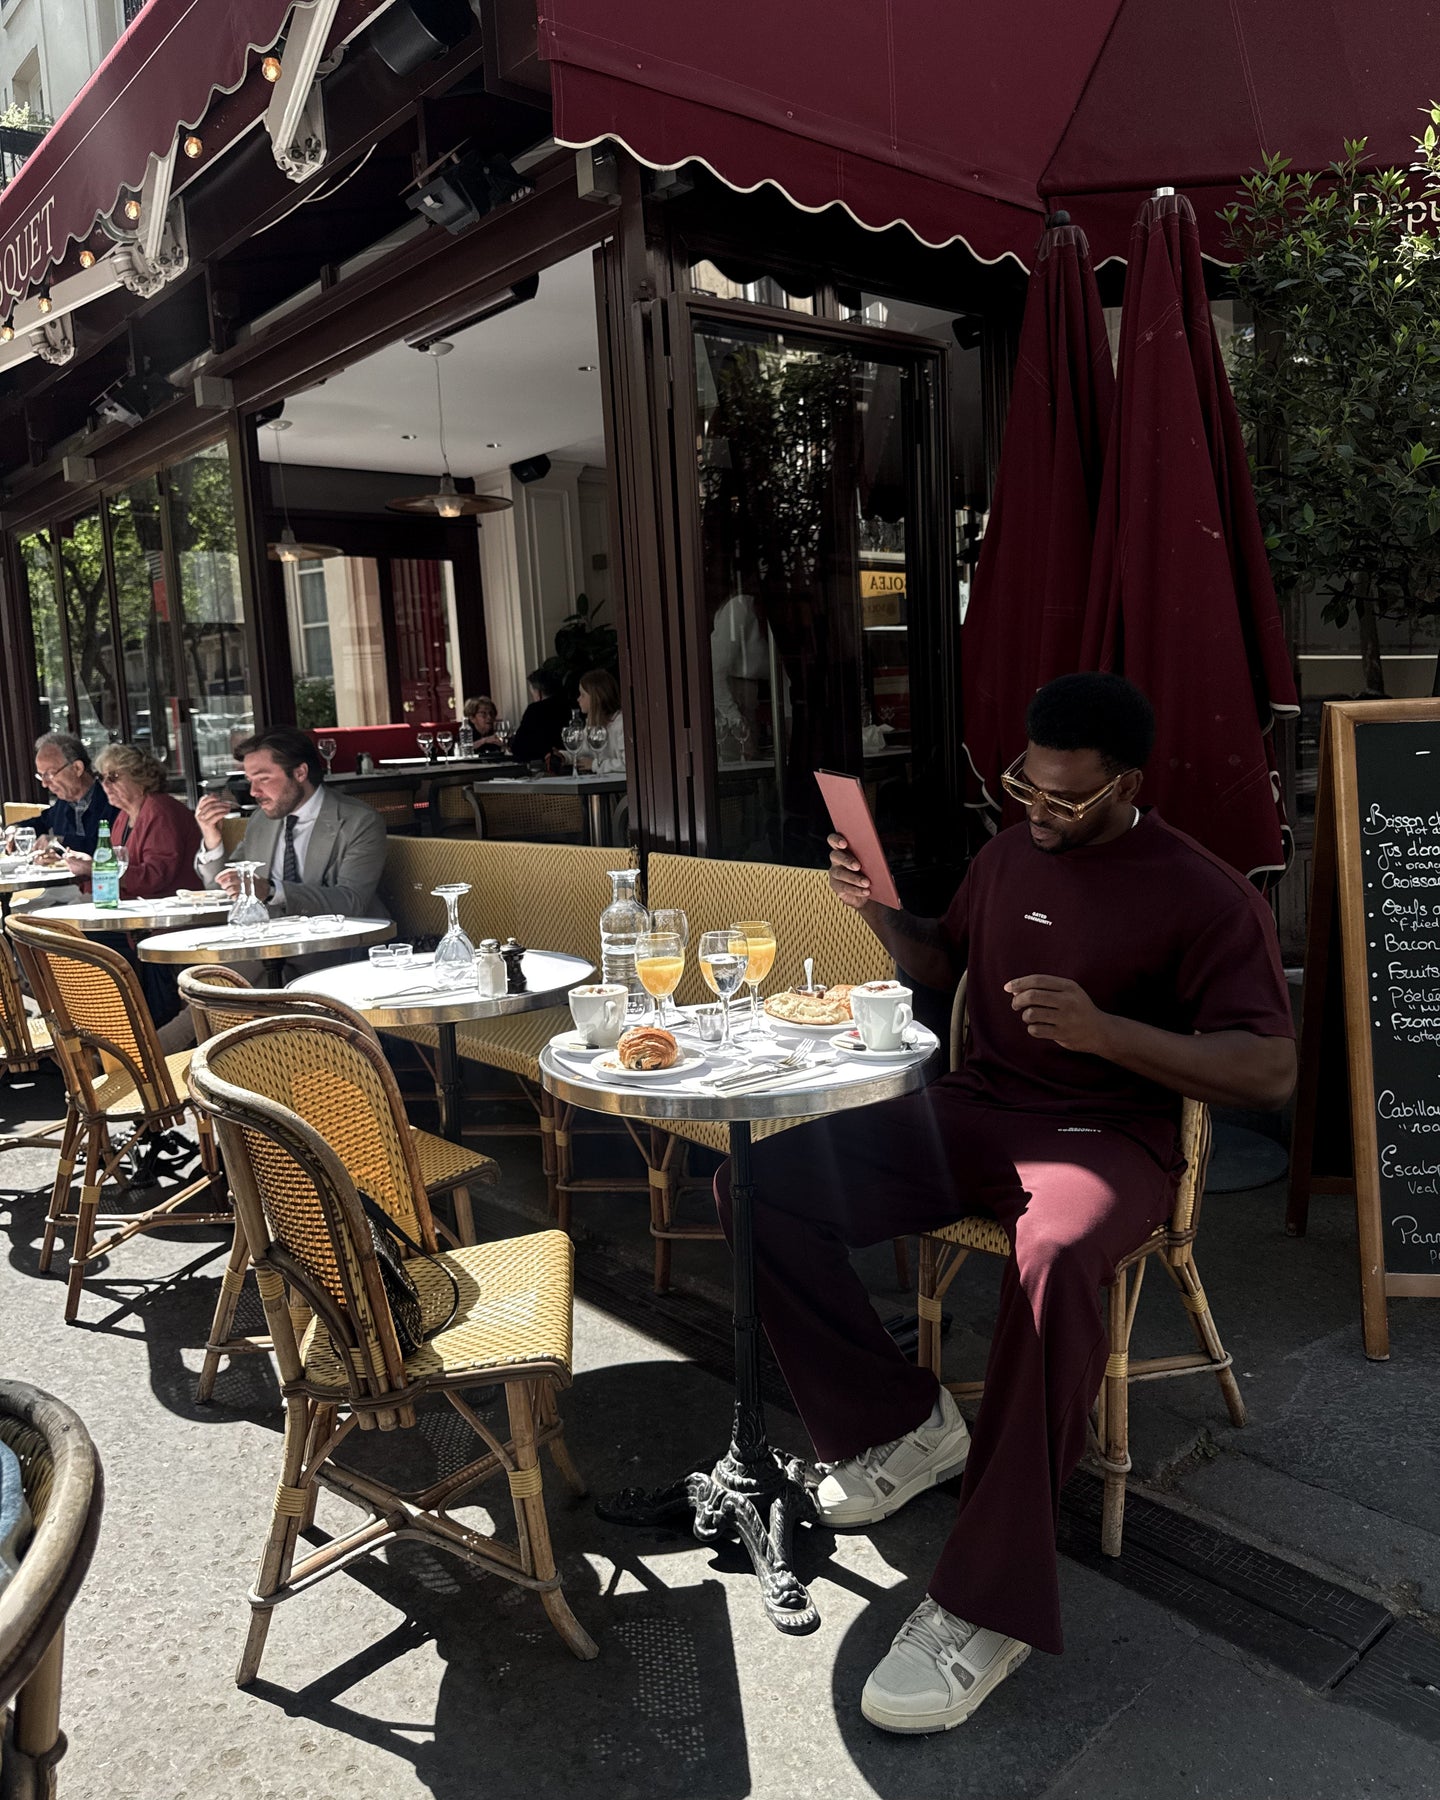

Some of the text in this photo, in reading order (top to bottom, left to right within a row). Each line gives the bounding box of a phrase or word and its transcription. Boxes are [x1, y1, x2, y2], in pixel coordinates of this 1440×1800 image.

[0, 195, 55, 305] QUET
[1377, 842, 1402, 871] Jus
[1384, 933, 1440, 952] Bacon
[1408, 1178, 1439, 1195] Veal
